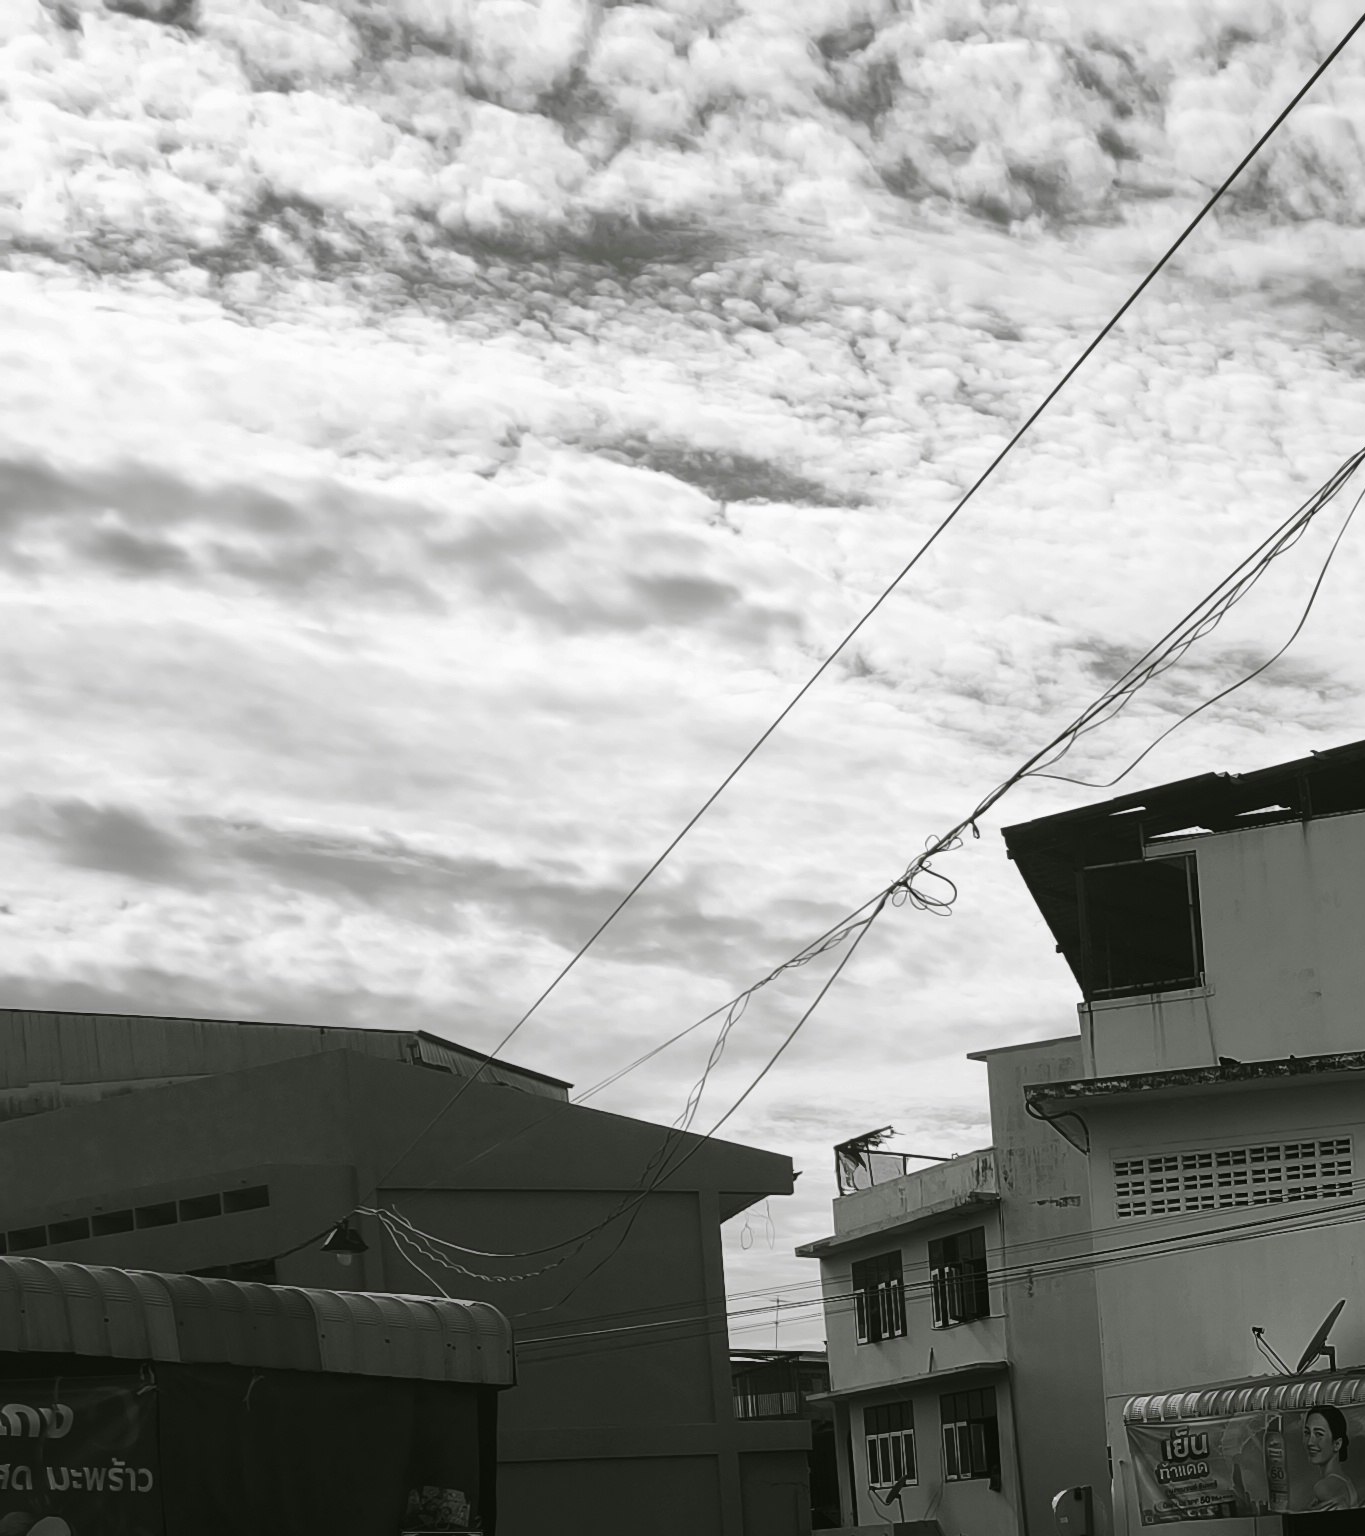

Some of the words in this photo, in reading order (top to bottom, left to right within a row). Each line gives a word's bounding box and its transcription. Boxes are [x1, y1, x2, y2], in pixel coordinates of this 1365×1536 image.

[1165, 1426, 1208, 1460] เย็น
[46, 1457, 153, 1492] มะพร้าว
